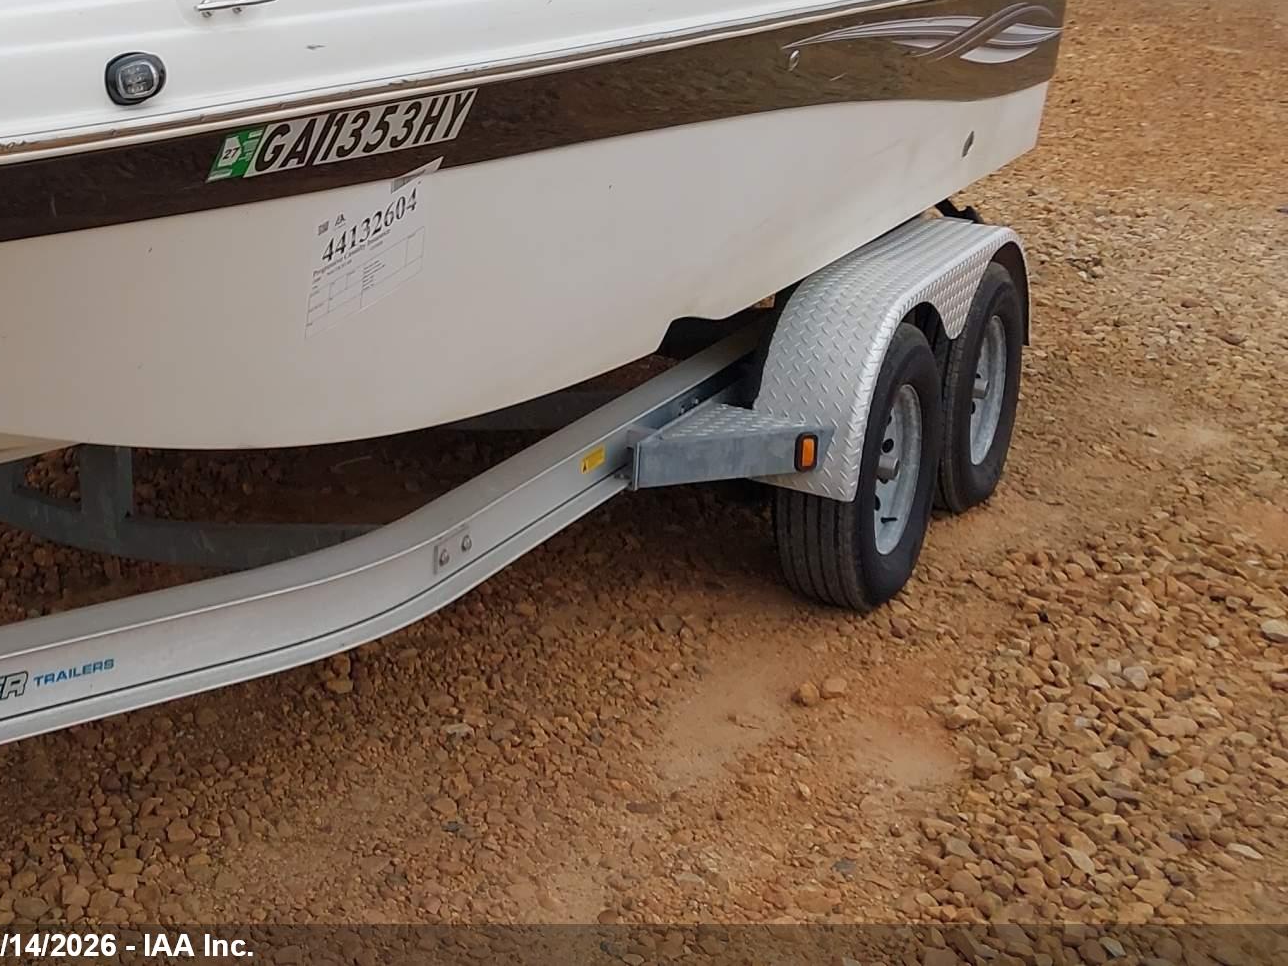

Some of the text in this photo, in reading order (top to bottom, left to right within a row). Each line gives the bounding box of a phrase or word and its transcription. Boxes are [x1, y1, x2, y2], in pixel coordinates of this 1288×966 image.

[222, 146, 240, 160] 27
[322, 187, 417, 262] 44132604
[33, 658, 114, 687] TRAILERS
